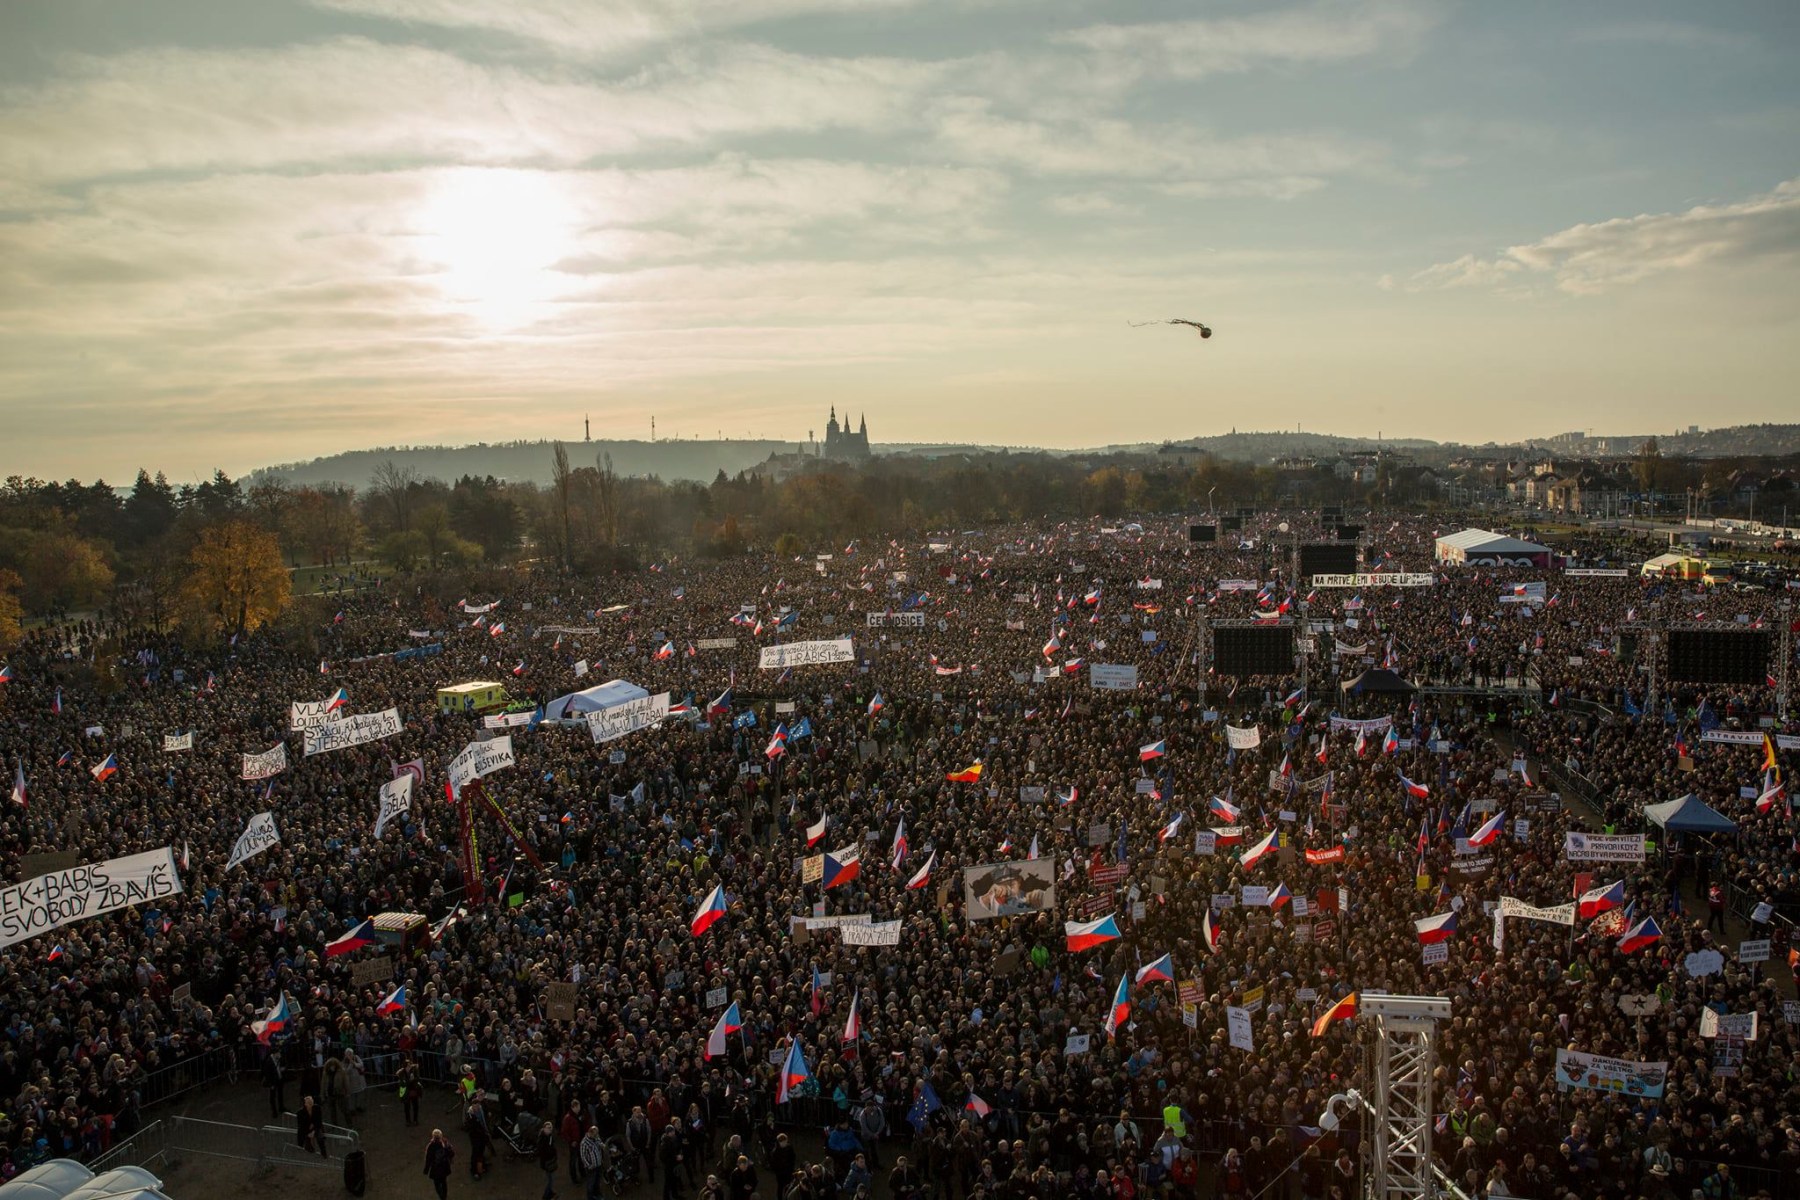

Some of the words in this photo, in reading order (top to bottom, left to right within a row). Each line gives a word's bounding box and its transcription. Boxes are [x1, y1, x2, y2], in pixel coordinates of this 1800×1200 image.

[1370, 573, 1398, 585] NEBUDE
[0, 862, 110, 917] EK+BABIŠ
[2, 890, 90, 938] SVOBODY
[95, 862, 173, 911] ZBAVÍŠ
[1526, 910, 1563, 921] COUNTRY
